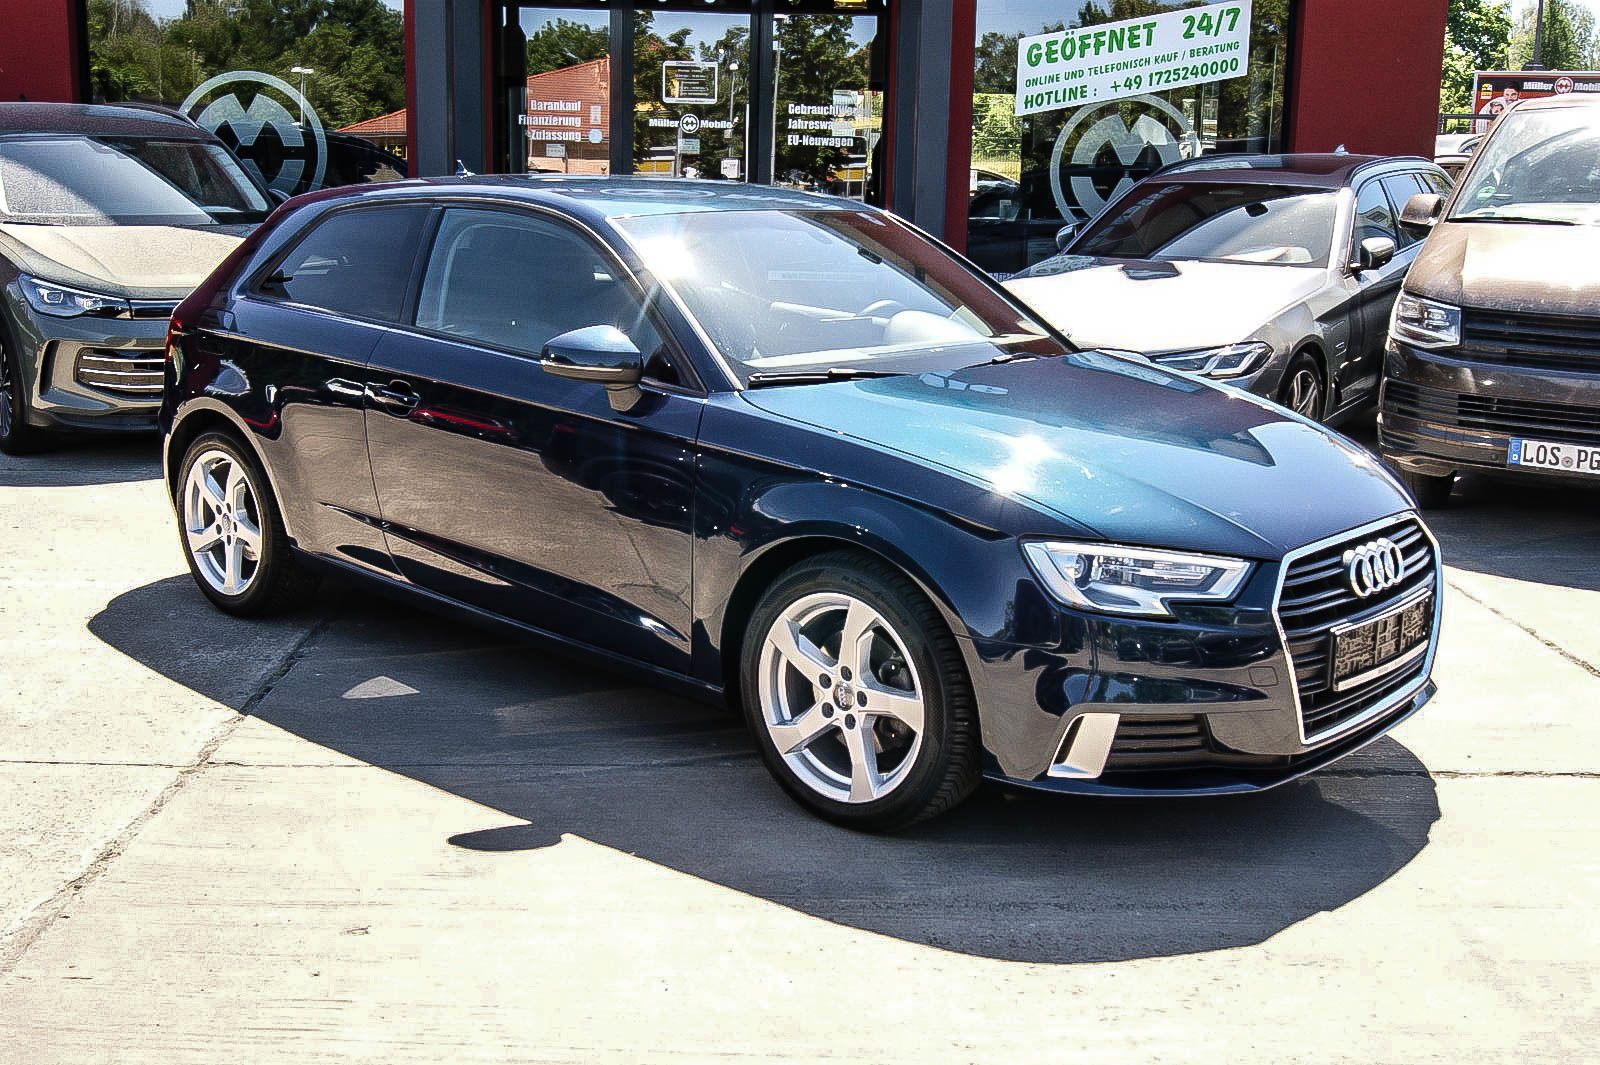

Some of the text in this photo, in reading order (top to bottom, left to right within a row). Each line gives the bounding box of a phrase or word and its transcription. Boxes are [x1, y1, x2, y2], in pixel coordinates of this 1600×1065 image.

[1026, 7, 1241, 67] GEÖFFNET 24/7
[1025, 40, 1240, 88] ONLINE UND TELEFONISCH KAUF / BERATUNG
[1024, 84, 1088, 110] HOTLINE
[1110, 74, 1143, 93] +49
[1148, 57, 1239, 87] 1725240000
[1523, 81, 1554, 90] Müller
[530, 99, 582, 112] Barankauf
[518, 114, 582, 128] Finanzierung
[648, 118, 732, 129] Müller Mobile
[531, 130, 582, 143] Zulassung
[787, 134, 854, 147] EU-Neuwagen
[1522, 442, 1561, 466] LOS
